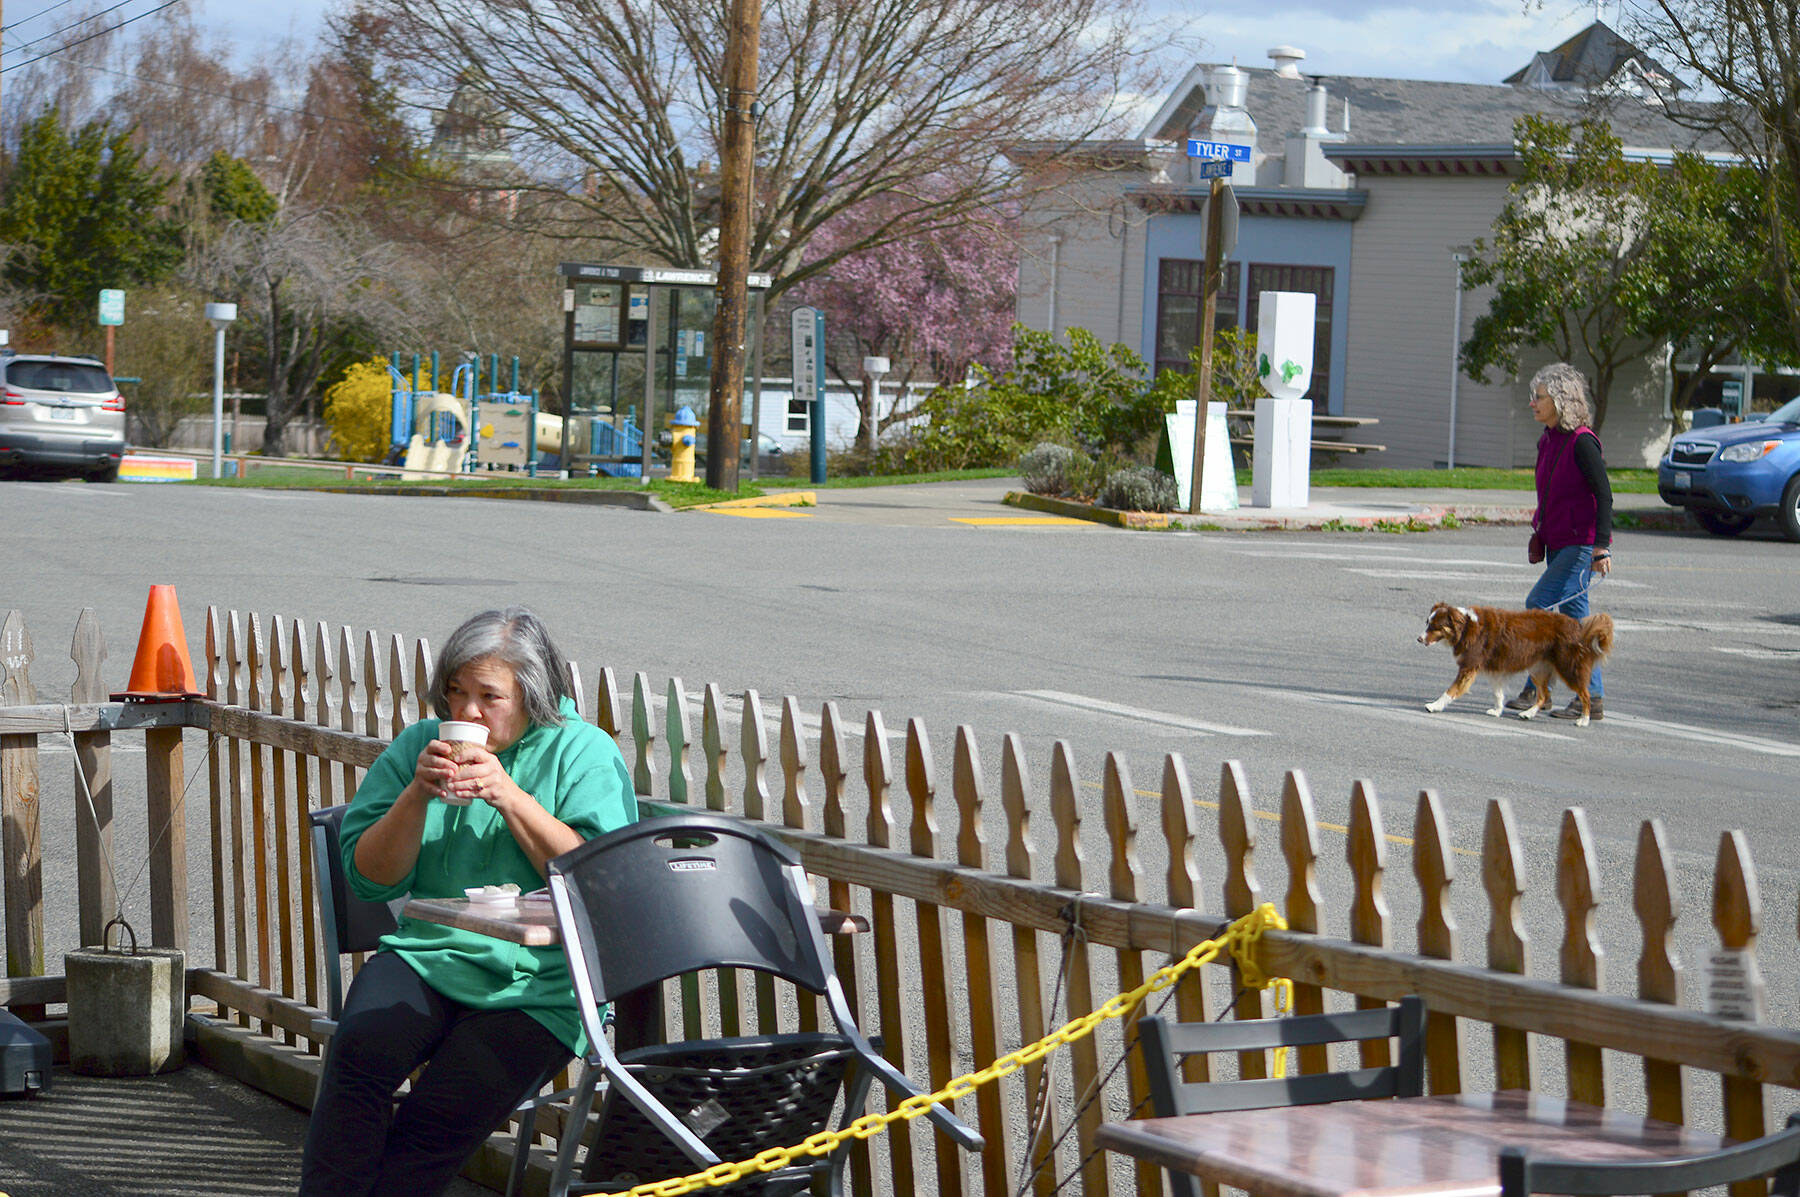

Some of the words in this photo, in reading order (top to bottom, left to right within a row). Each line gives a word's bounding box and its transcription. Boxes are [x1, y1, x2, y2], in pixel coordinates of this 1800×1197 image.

[1195, 142, 1229, 159] TYLER
[1234, 149, 1242, 157] ST
[655, 271, 711, 283] LAWRENCE
